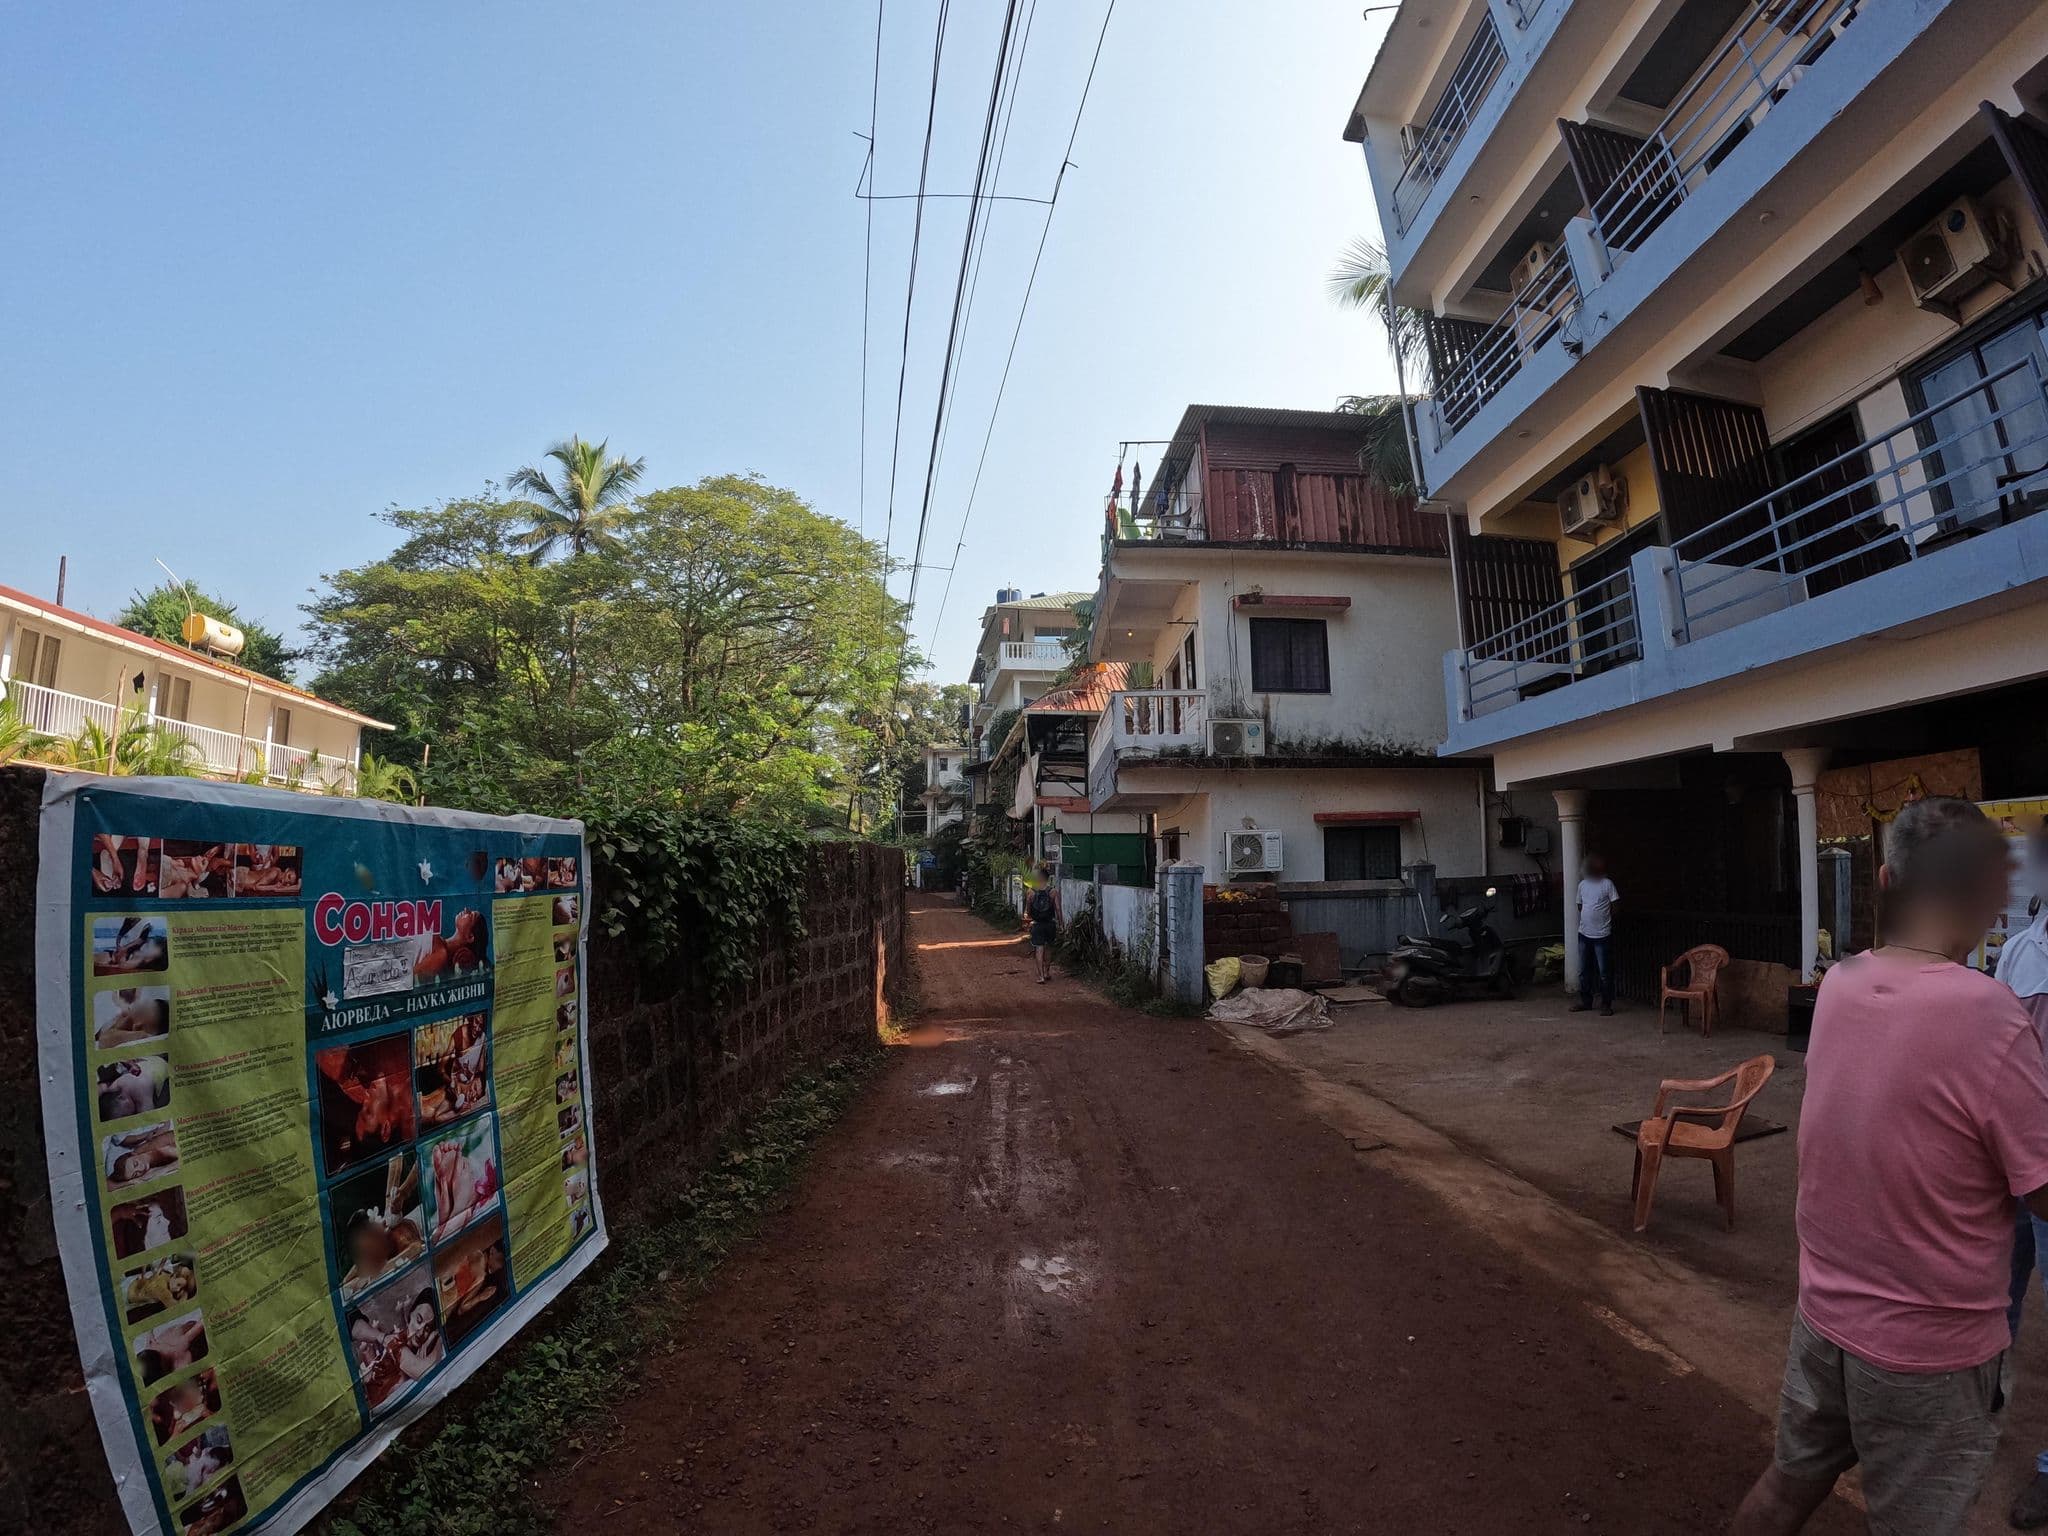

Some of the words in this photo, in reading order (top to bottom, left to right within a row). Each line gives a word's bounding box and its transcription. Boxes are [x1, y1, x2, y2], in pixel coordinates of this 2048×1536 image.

[314, 892, 442, 946] Сонам
[321, 1006, 390, 1032] АЮРВЕДА
[407, 992, 446, 1012] НАУКА
[447, 982, 485, 1003] ЖИЗНИ
